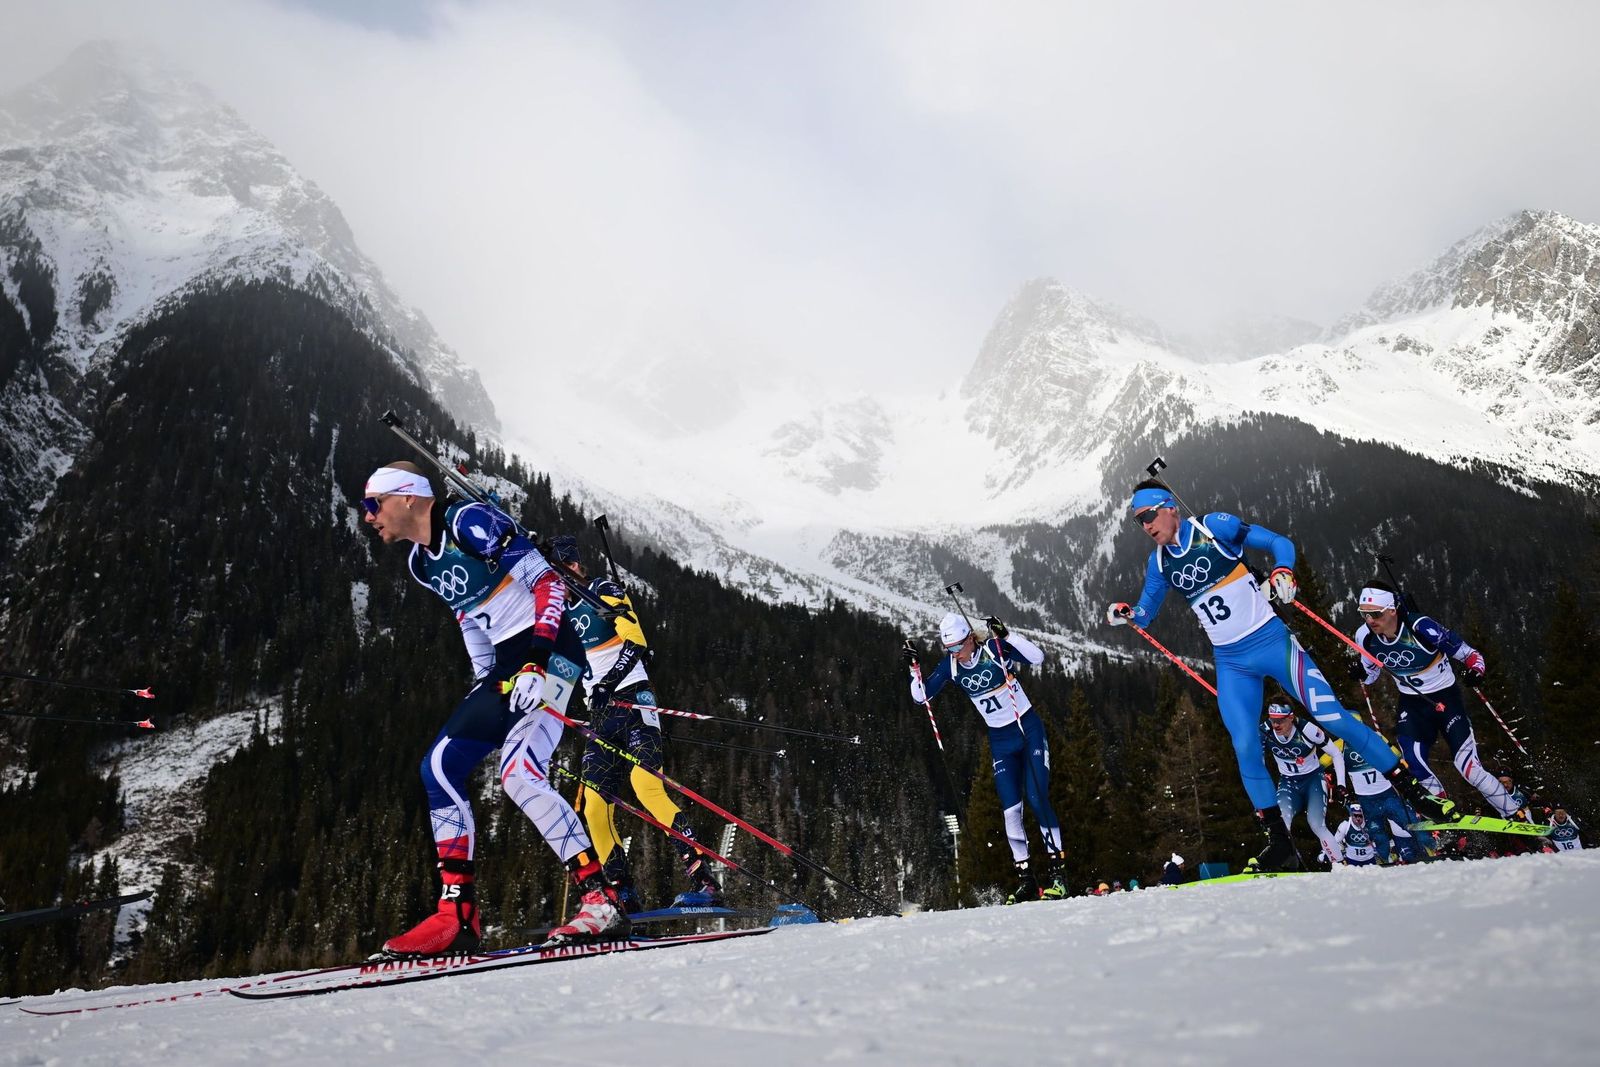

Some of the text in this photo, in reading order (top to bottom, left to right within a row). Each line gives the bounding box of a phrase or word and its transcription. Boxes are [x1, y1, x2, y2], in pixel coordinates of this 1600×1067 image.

[538, 580, 566, 628] FRANC
[1199, 595, 1231, 626] 13
[475, 612, 492, 630] 7
[615, 648, 635, 671] SWE
[554, 683, 564, 701] 7
[979, 695, 1003, 714] 21
[1362, 771, 1377, 785] 17
[1354, 848, 1367, 856] 18
[1561, 841, 1575, 850] 16
